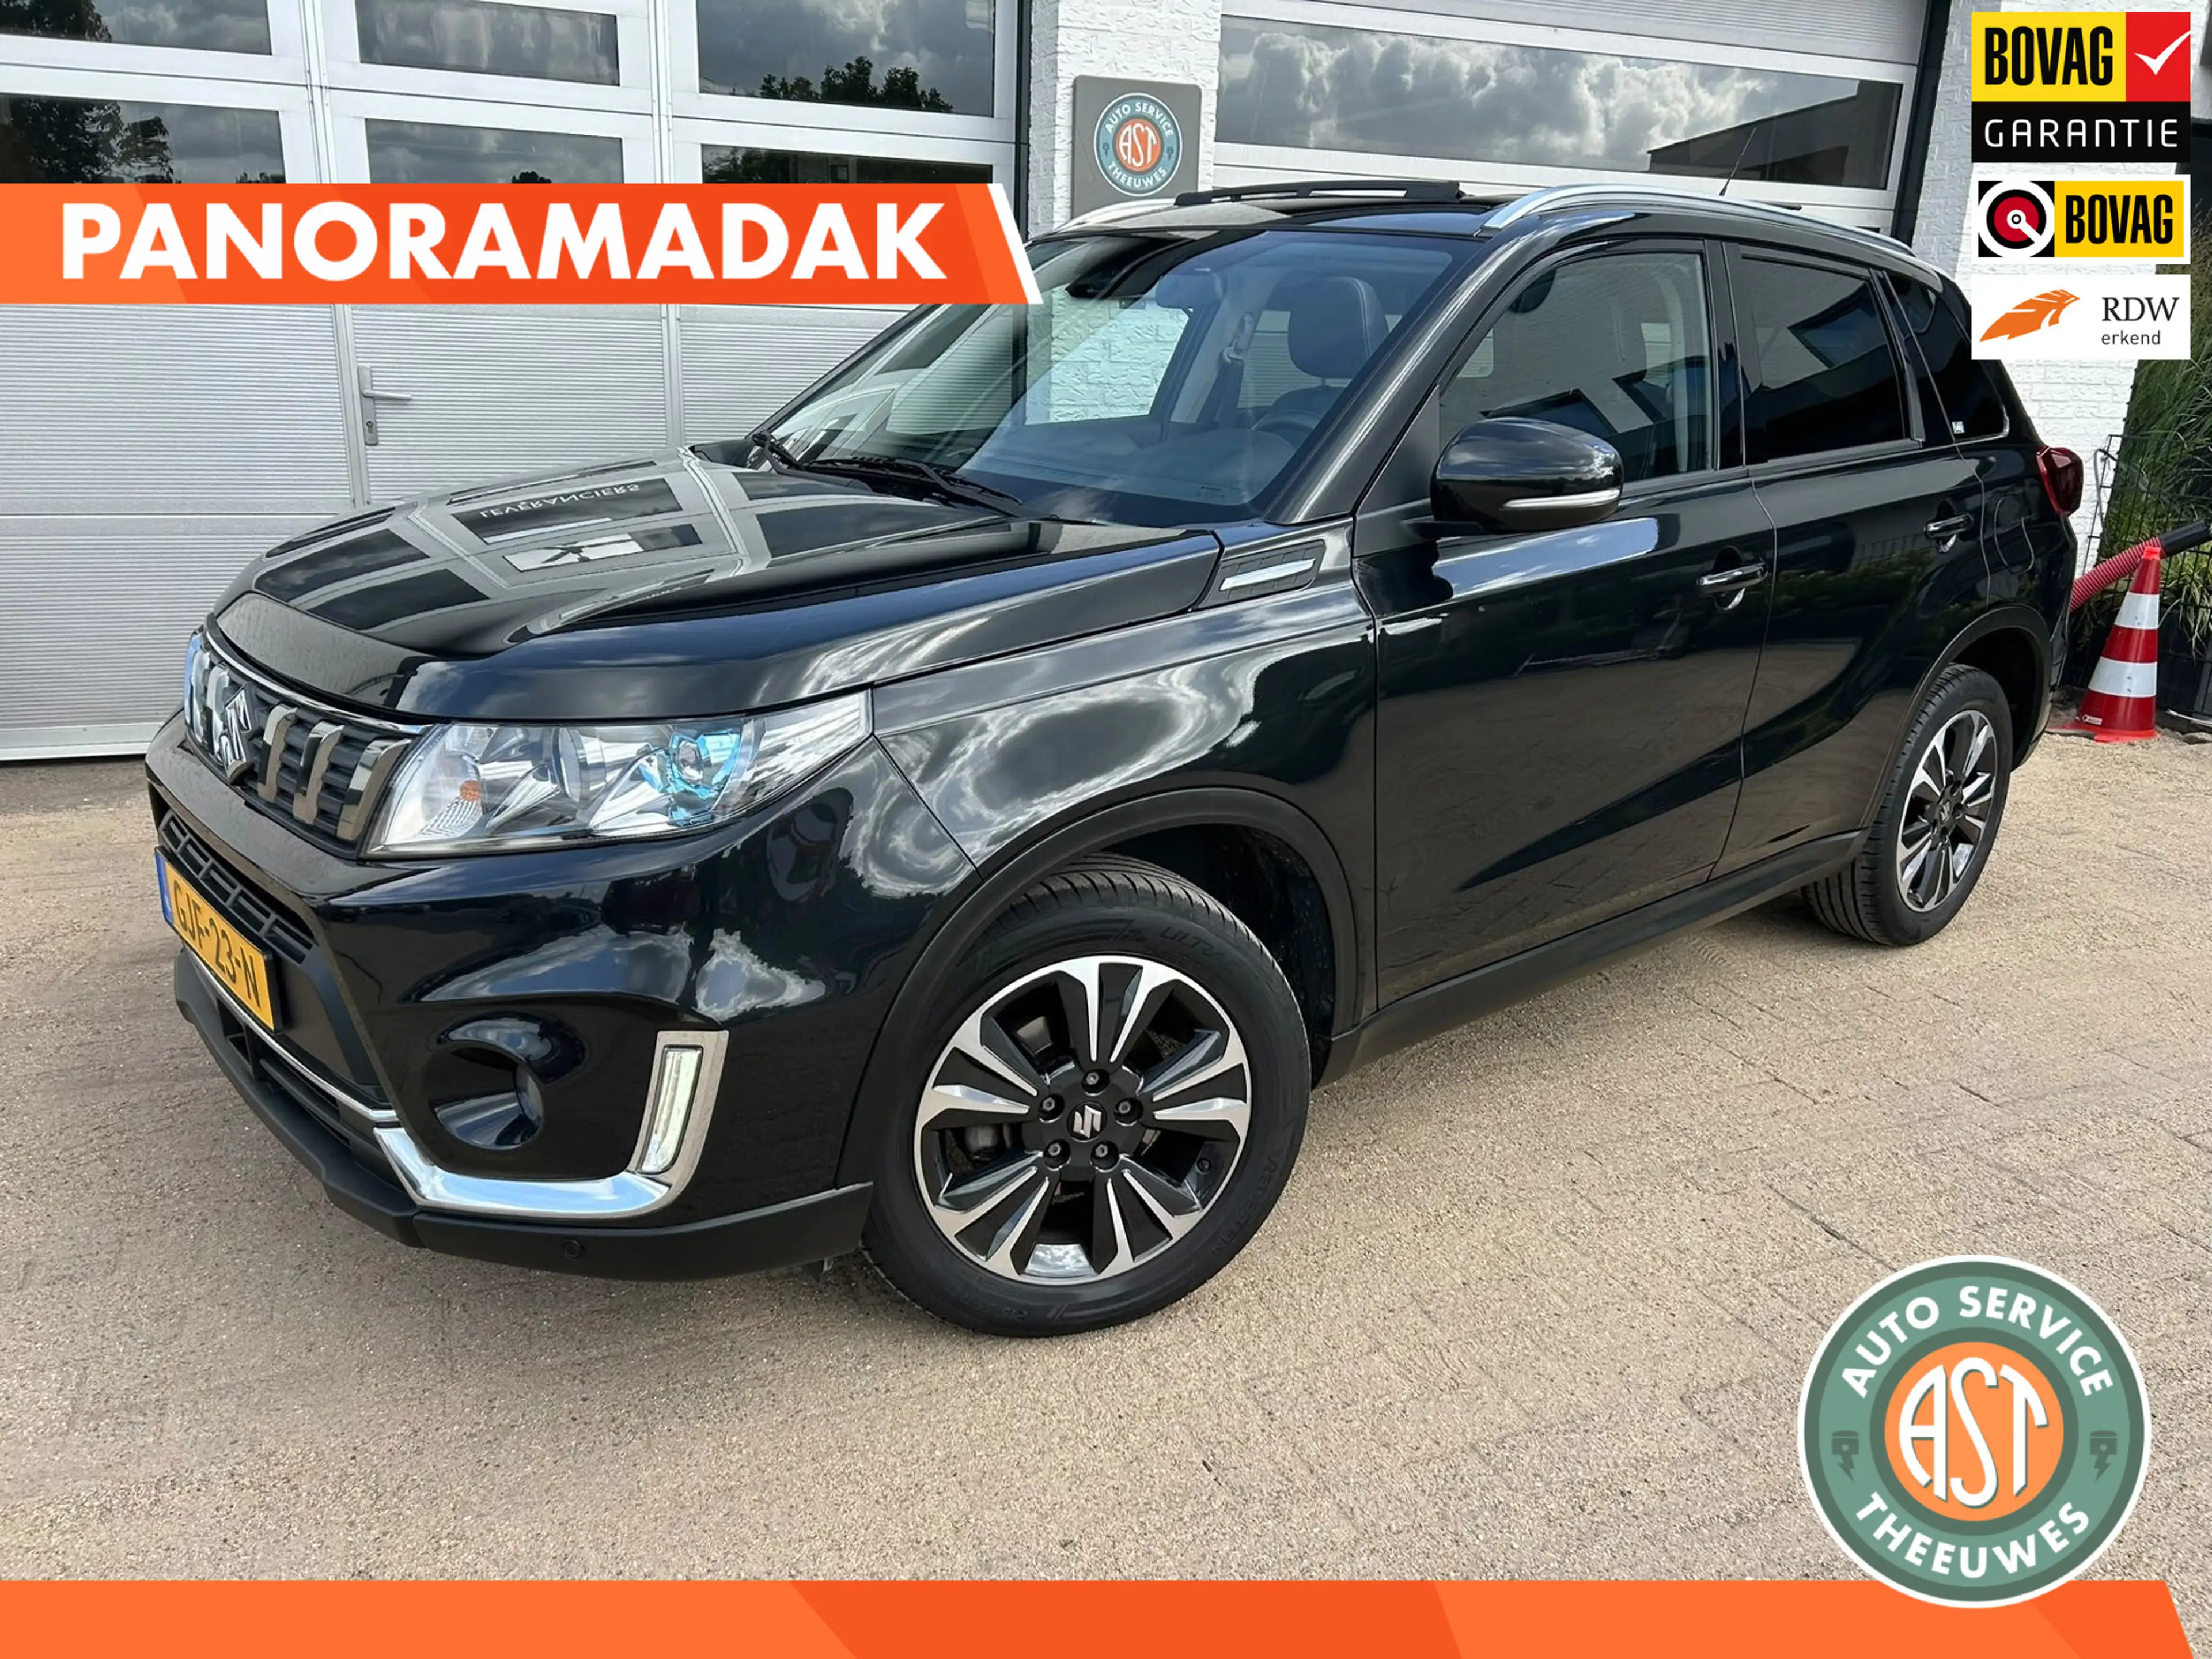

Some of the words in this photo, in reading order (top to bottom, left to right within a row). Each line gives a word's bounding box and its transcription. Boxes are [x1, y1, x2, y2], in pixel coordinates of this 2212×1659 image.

[1105, 104, 1131, 134] AUTO
[1134, 101, 1175, 138] SERVICE
[1119, 123, 1157, 167] AST
[1107, 161, 1167, 188] THEEUWES
[174, 879, 261, 1009] GJF-23-N
